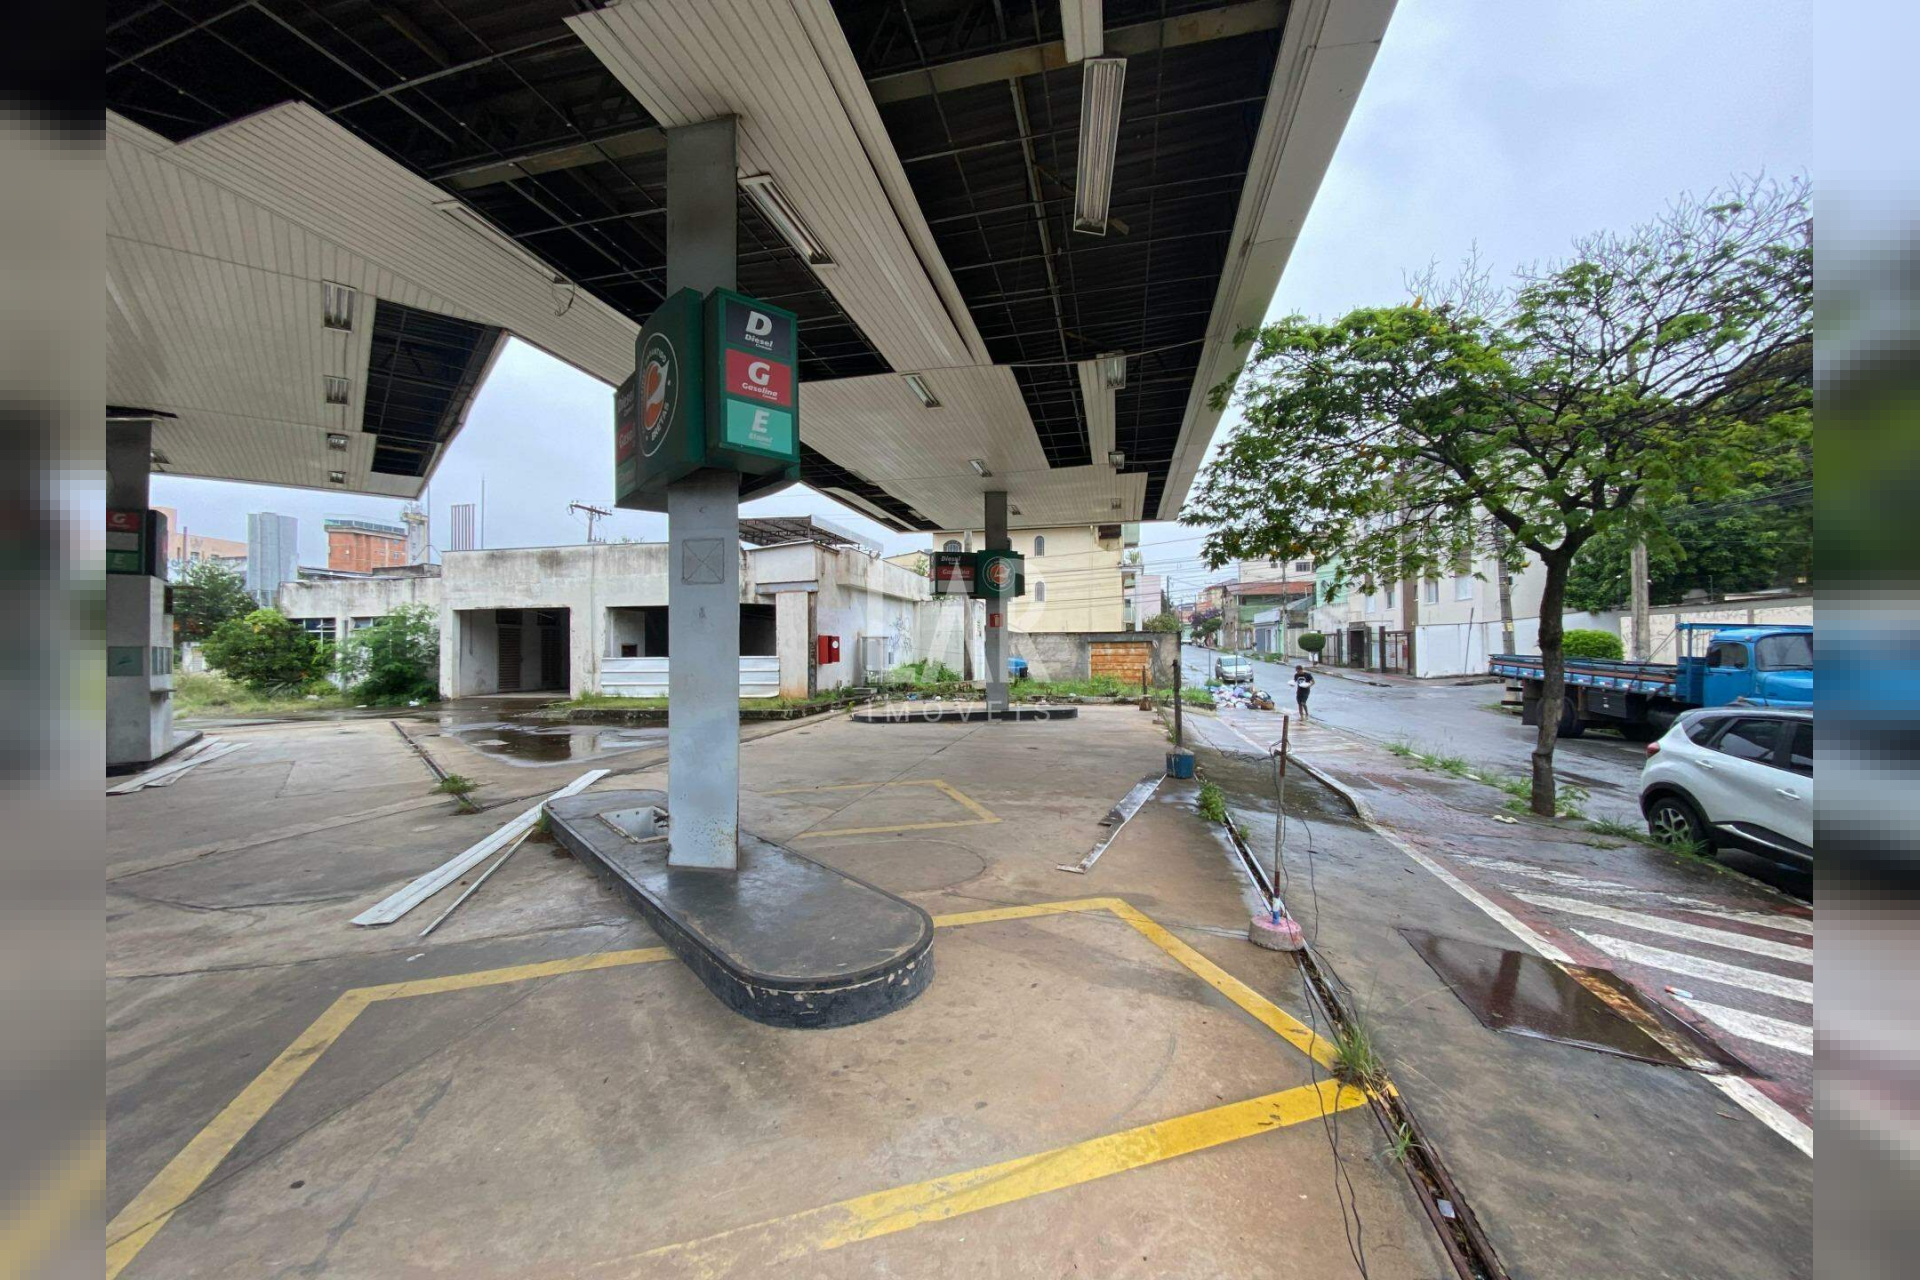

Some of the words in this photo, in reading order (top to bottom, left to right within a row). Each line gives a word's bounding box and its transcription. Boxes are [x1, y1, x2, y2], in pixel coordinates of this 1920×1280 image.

[745, 311, 773, 336] D
[744, 333, 774, 347] Diesel
[748, 361, 771, 386] G
[752, 408, 770, 433] E
[112, 513, 126, 524] G
